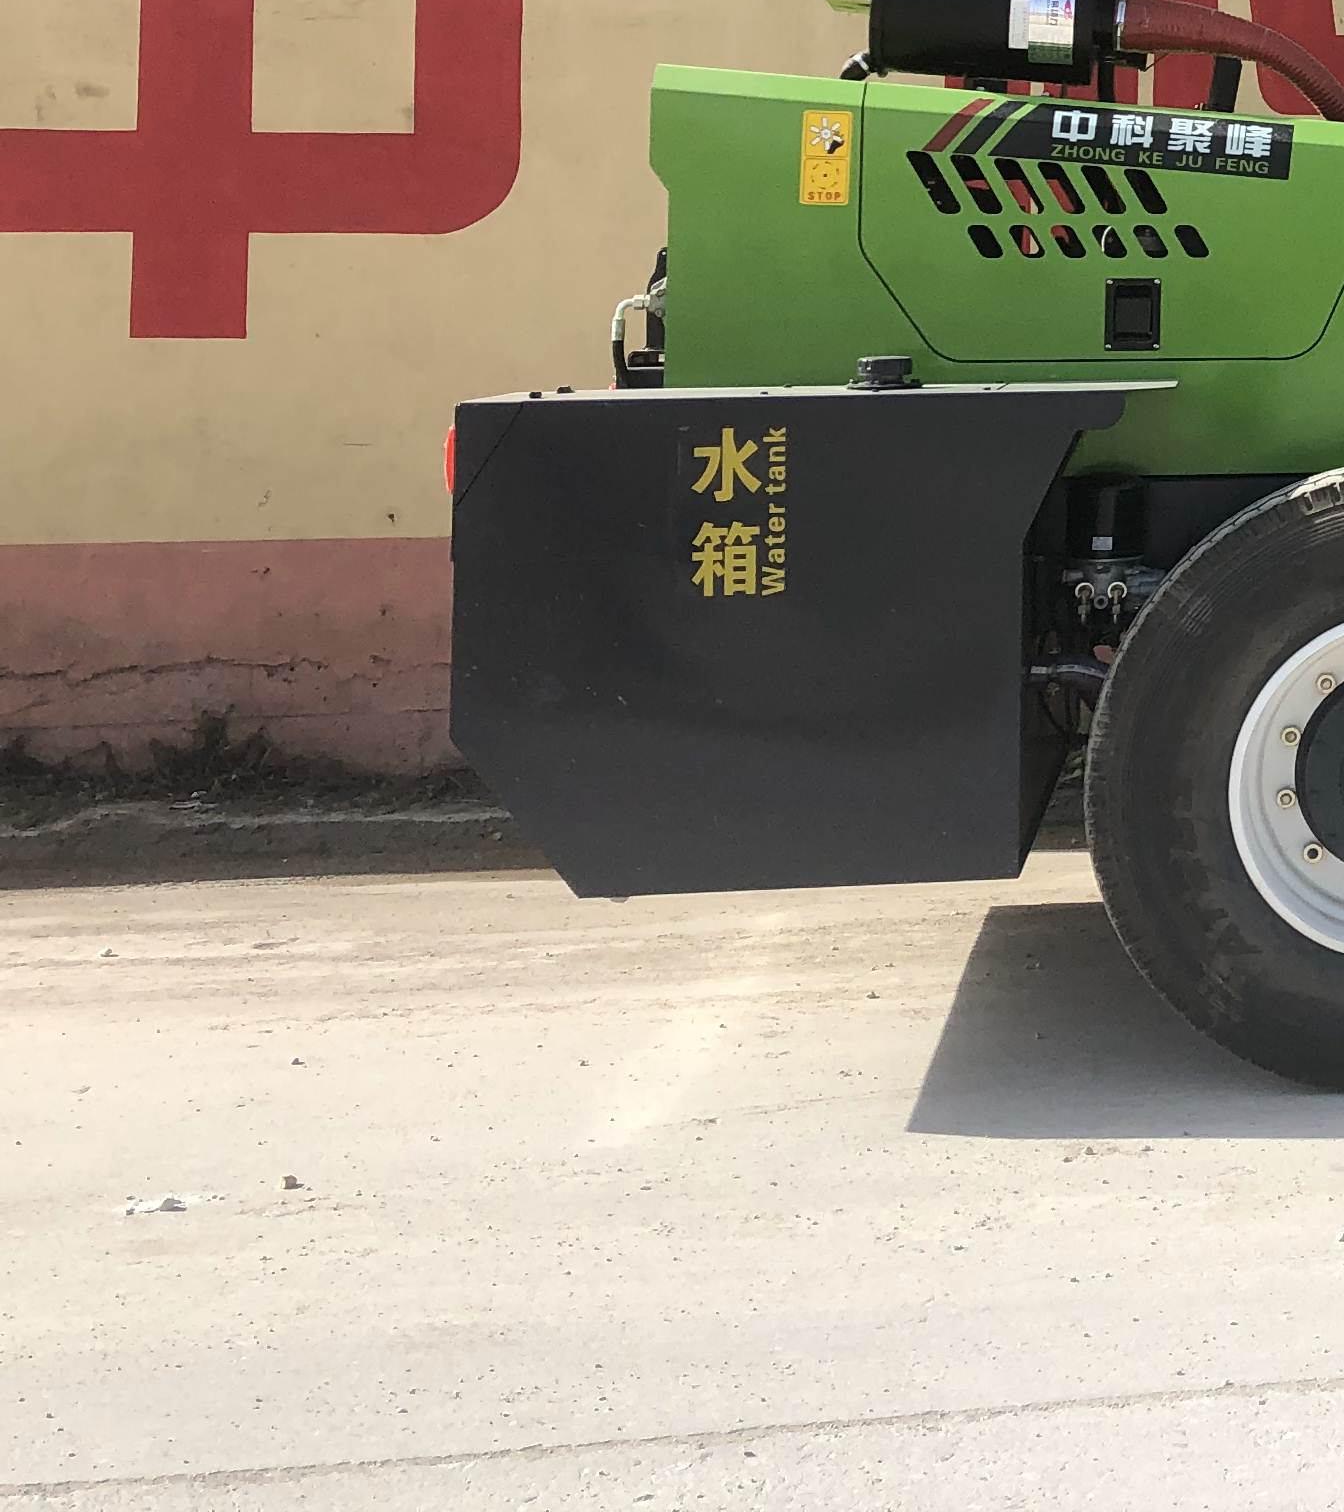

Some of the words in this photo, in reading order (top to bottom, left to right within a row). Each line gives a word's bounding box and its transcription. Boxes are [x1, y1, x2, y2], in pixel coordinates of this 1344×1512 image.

[1050, 143, 1126, 163] ZHONG
[1138, 150, 1164, 166] KE
[1175, 154, 1203, 169] JU
[1214, 157, 1271, 175] FENG
[1051, 109, 1273, 158] 中科聚峰
[807, 191, 842, 201] STOP
[762, 426, 787, 496] tank
[691, 427, 762, 597] 水箱
[761, 502, 787, 596] Water
